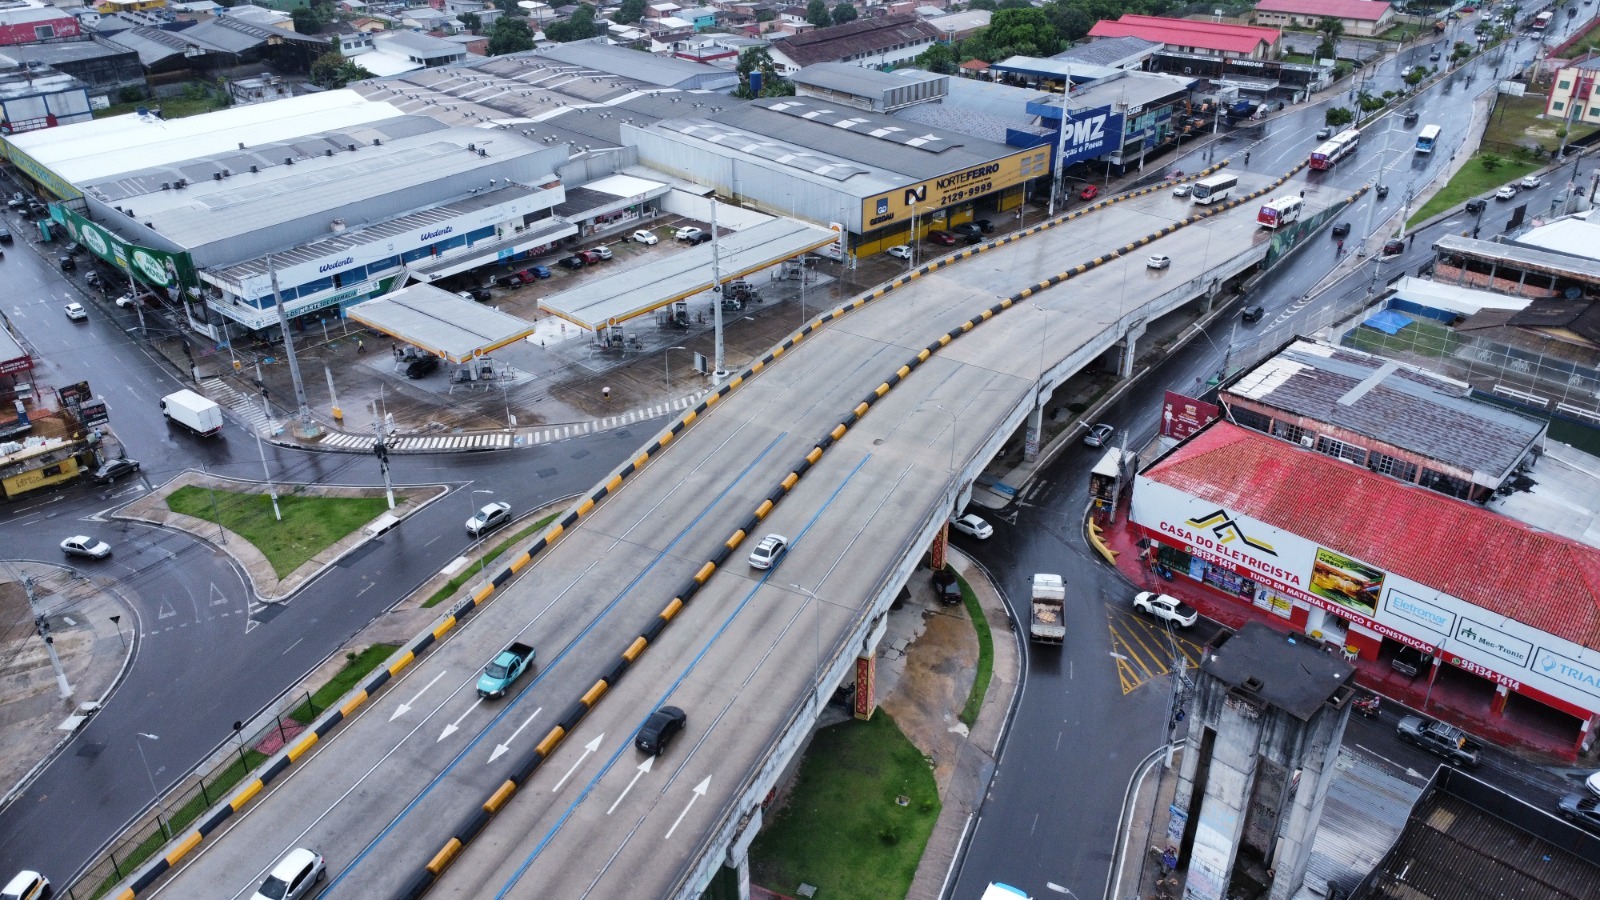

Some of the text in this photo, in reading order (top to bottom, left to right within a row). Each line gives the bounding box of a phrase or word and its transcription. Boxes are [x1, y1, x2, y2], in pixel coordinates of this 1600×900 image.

[1127, 105, 1143, 116] CASE
[1084, 140, 1103, 151] Pneus
[940, 182, 992, 206] 2129-9999
[1159, 521, 1193, 542] CASA
[1196, 535, 1214, 549] DO
[1216, 544, 1300, 586] ELETRICISTA
[1192, 546, 1237, 572] 98134-1414
[1250, 571, 1272, 586] TUDO
[1273, 581, 1287, 592] EM
[1286, 585, 1325, 608] MATERIAL
[1326, 605, 1365, 624] ELÉTRICO
[1373, 624, 1434, 653] CONSTRUÇÃO
[1393, 596, 1448, 625] Eletromar
[1478, 637, 1525, 660] Mec-Tronic
[1462, 660, 1520, 690] 98134-1414
